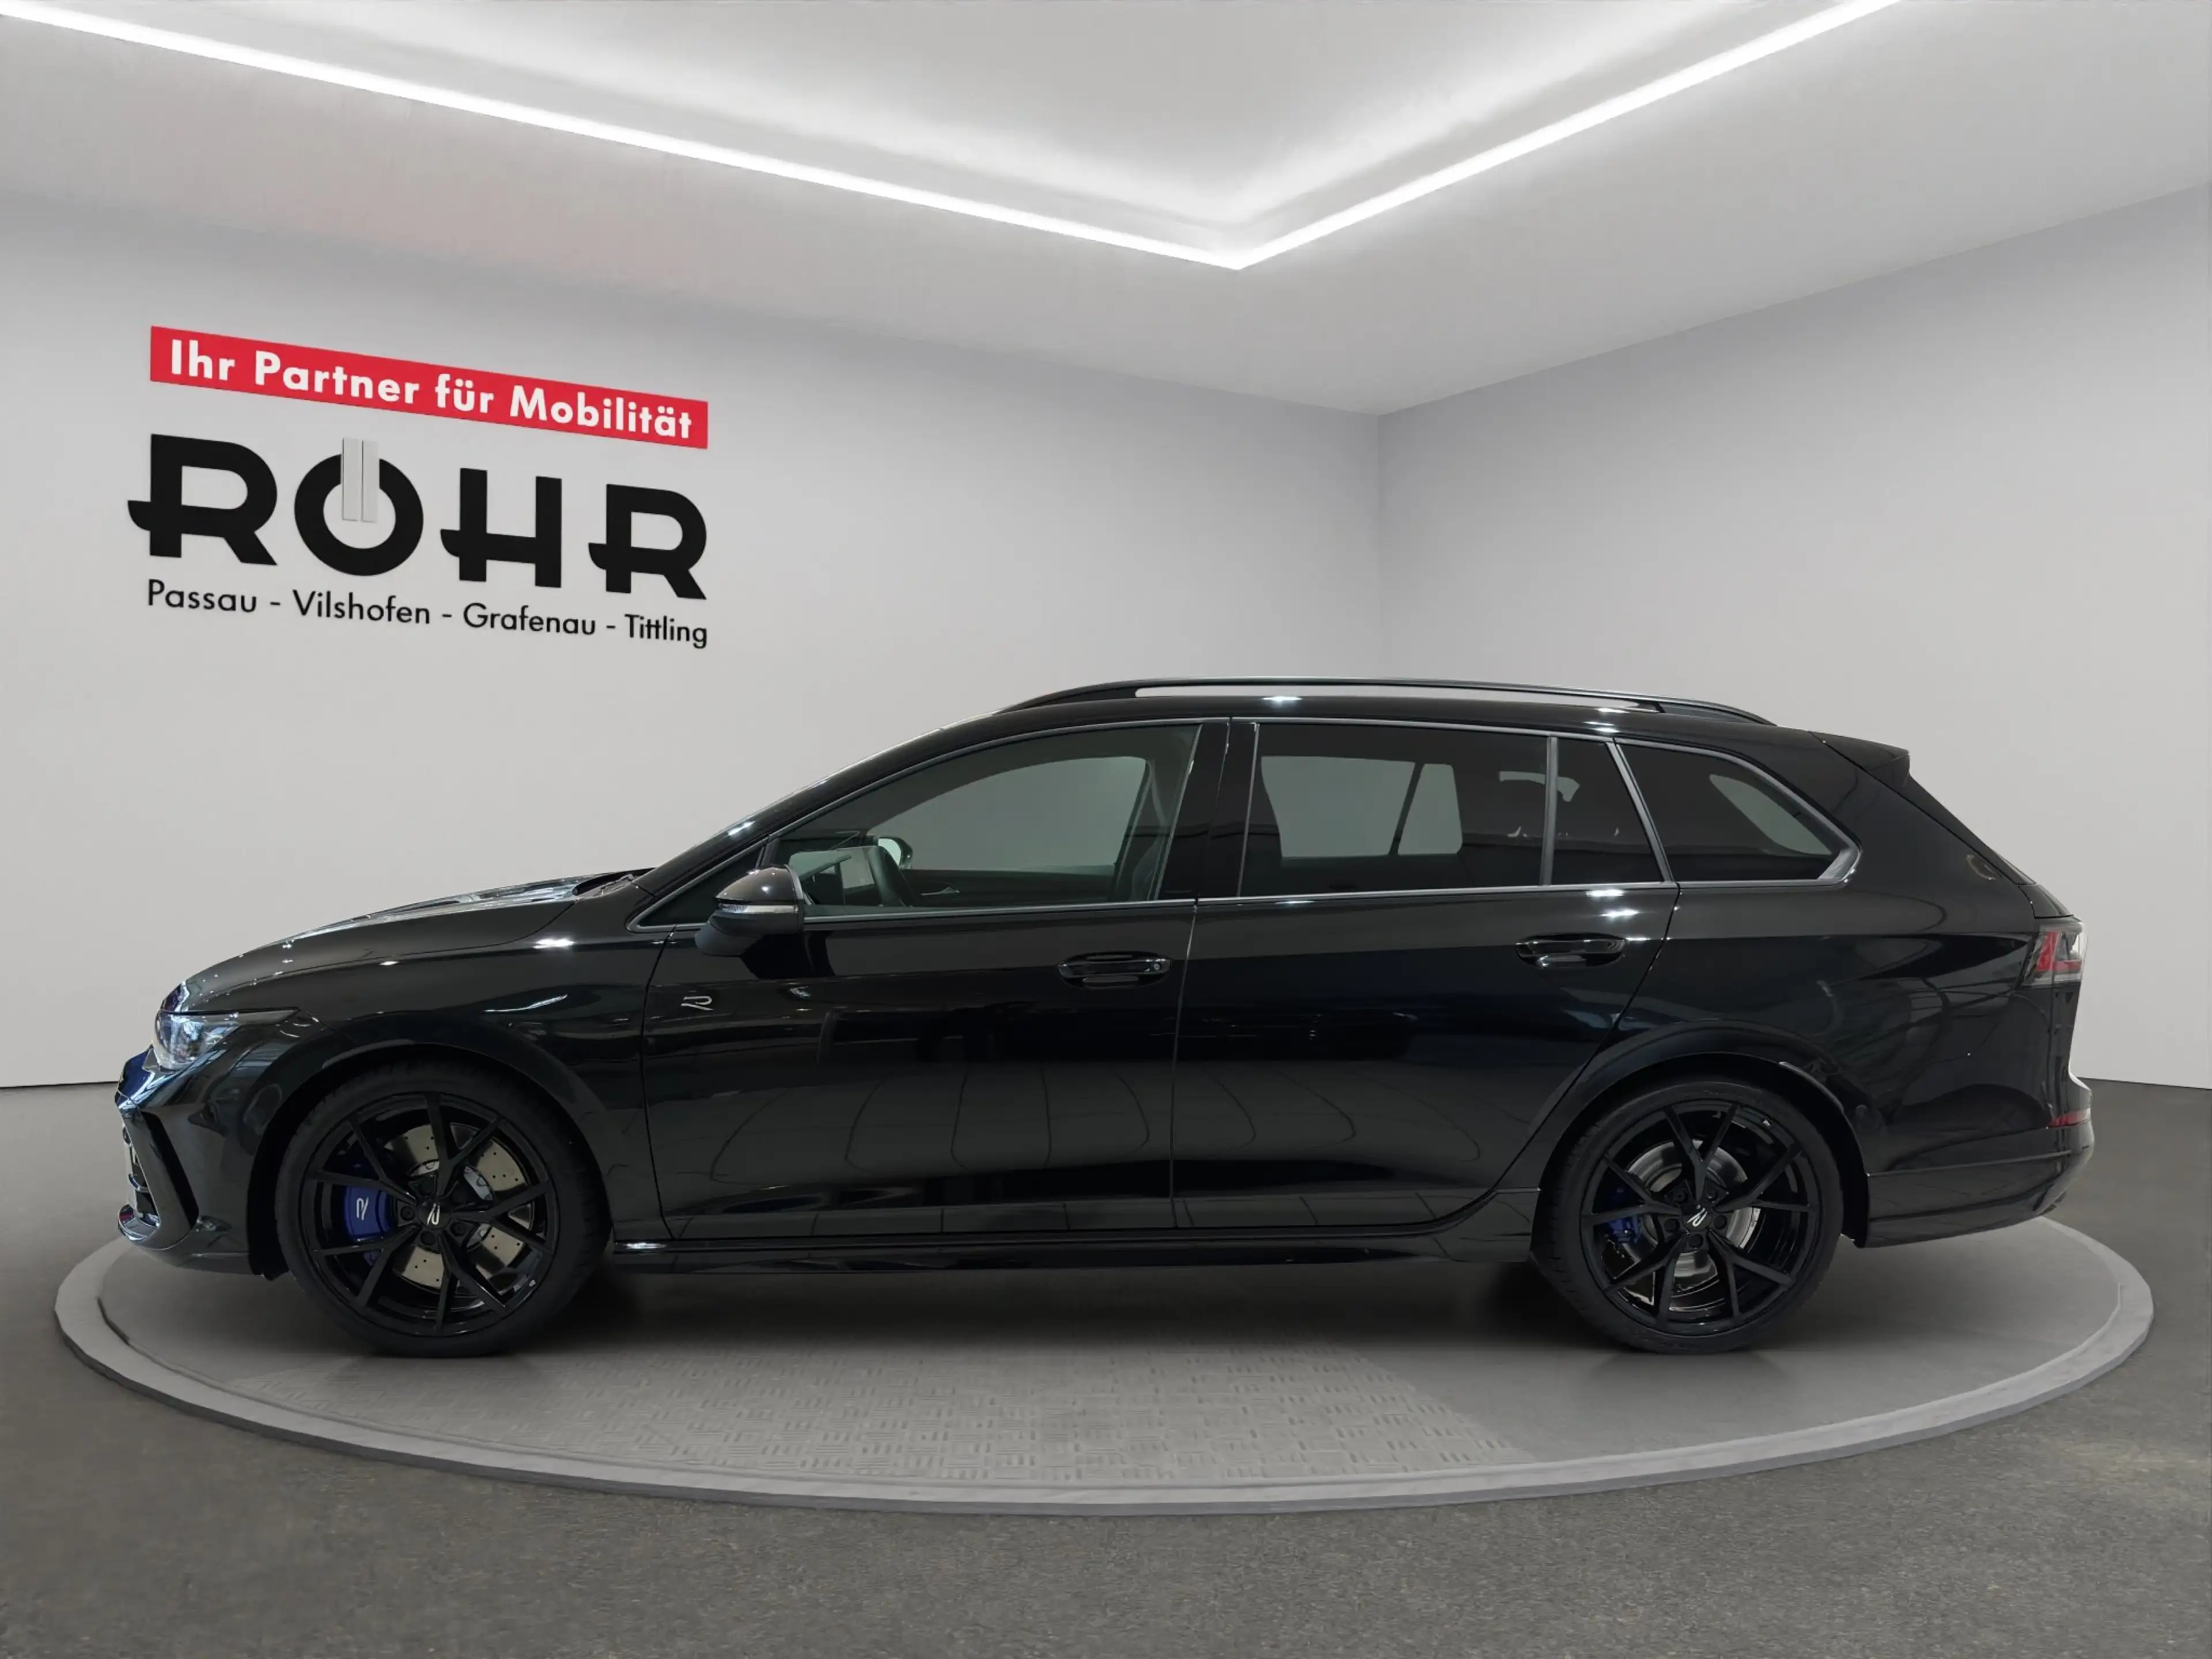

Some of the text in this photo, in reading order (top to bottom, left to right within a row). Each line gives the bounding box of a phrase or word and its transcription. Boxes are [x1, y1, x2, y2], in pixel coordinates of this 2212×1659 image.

[171, 339, 692, 439] Ihr Partner für Mobilität
[148, 578, 257, 613] Passau
[292, 589, 430, 625] Vilshofen
[463, 603, 596, 636] Grafenau
[624, 613, 707, 649] Tittling
